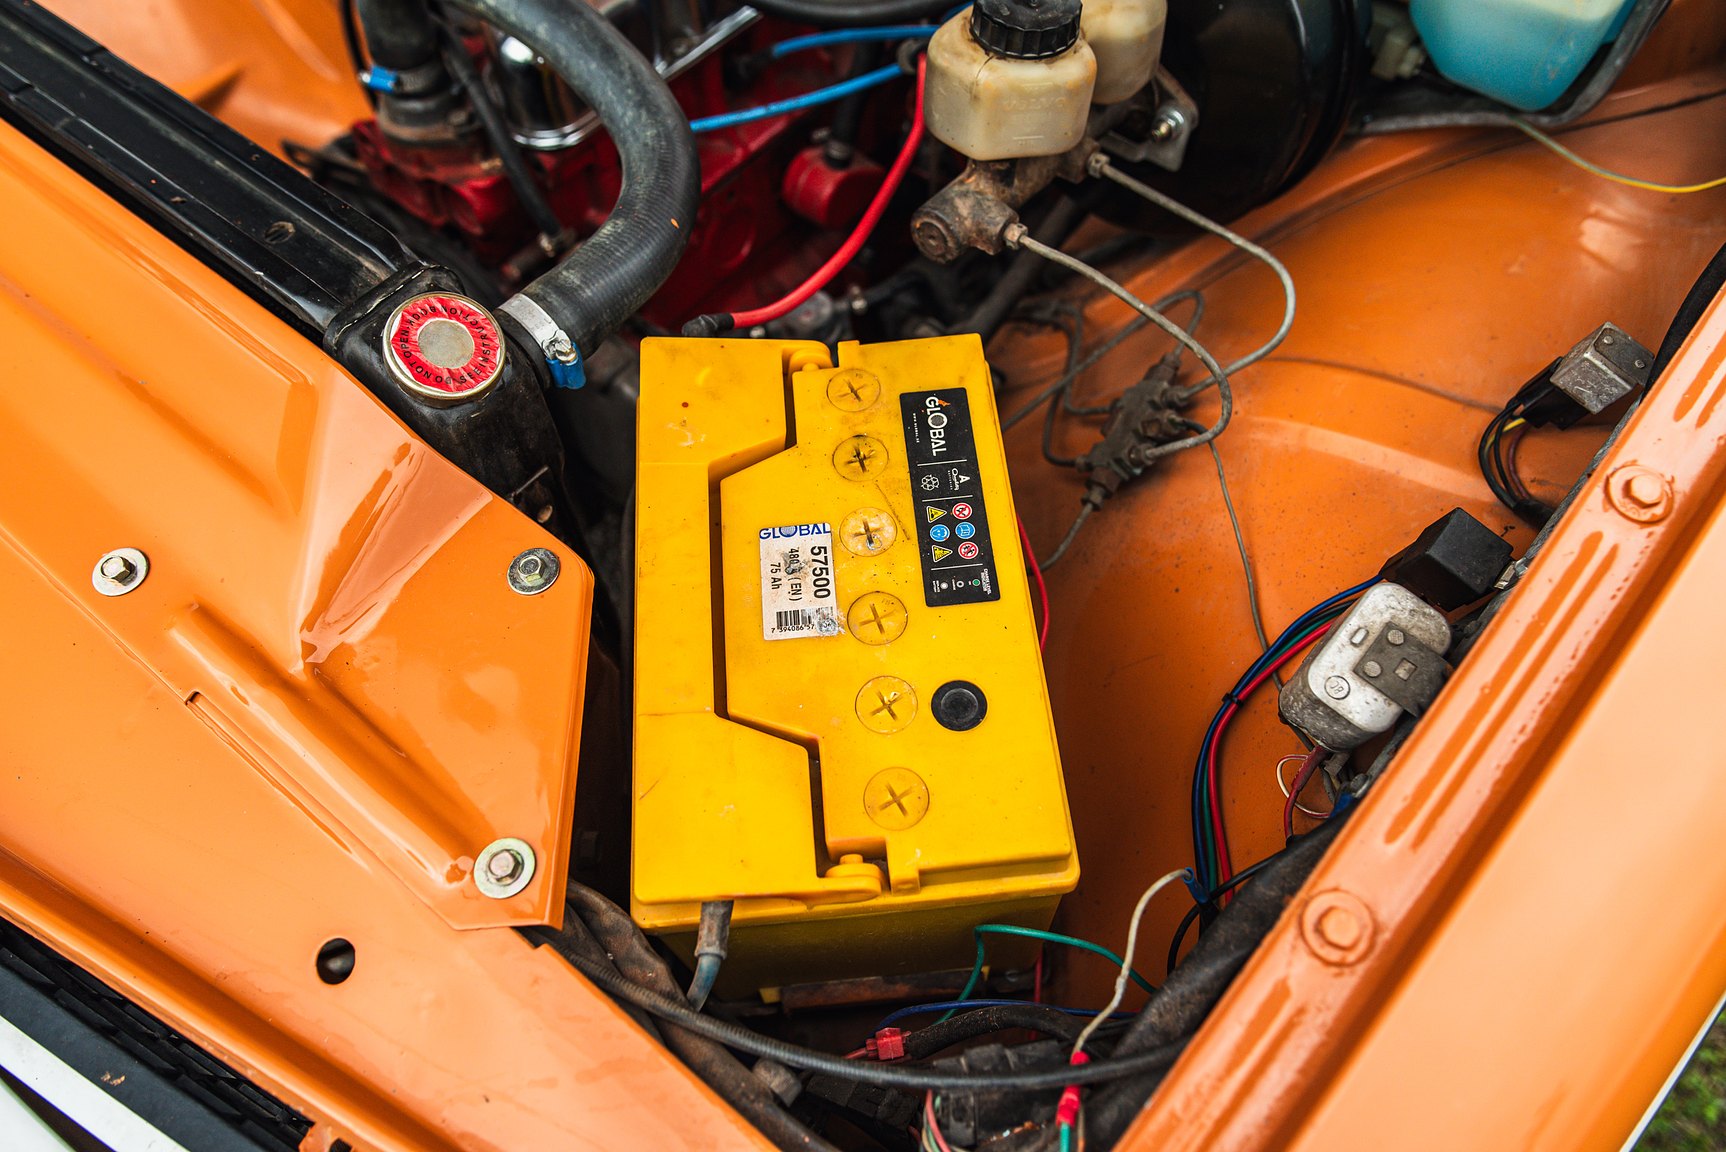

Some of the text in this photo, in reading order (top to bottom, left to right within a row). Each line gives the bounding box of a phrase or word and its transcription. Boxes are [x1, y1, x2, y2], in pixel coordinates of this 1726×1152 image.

[441, 305, 491, 368] INSTRUCTION
[408, 360, 432, 379] NOT
[459, 366, 482, 384] SEE
[435, 375, 453, 385] DO
[925, 396, 948, 457] GLOBAL
[958, 474, 971, 483] A
[759, 523, 831, 540] GLOBAL
[770, 562, 783, 590] 75 Ah
[810, 546, 831, 599] 57500
